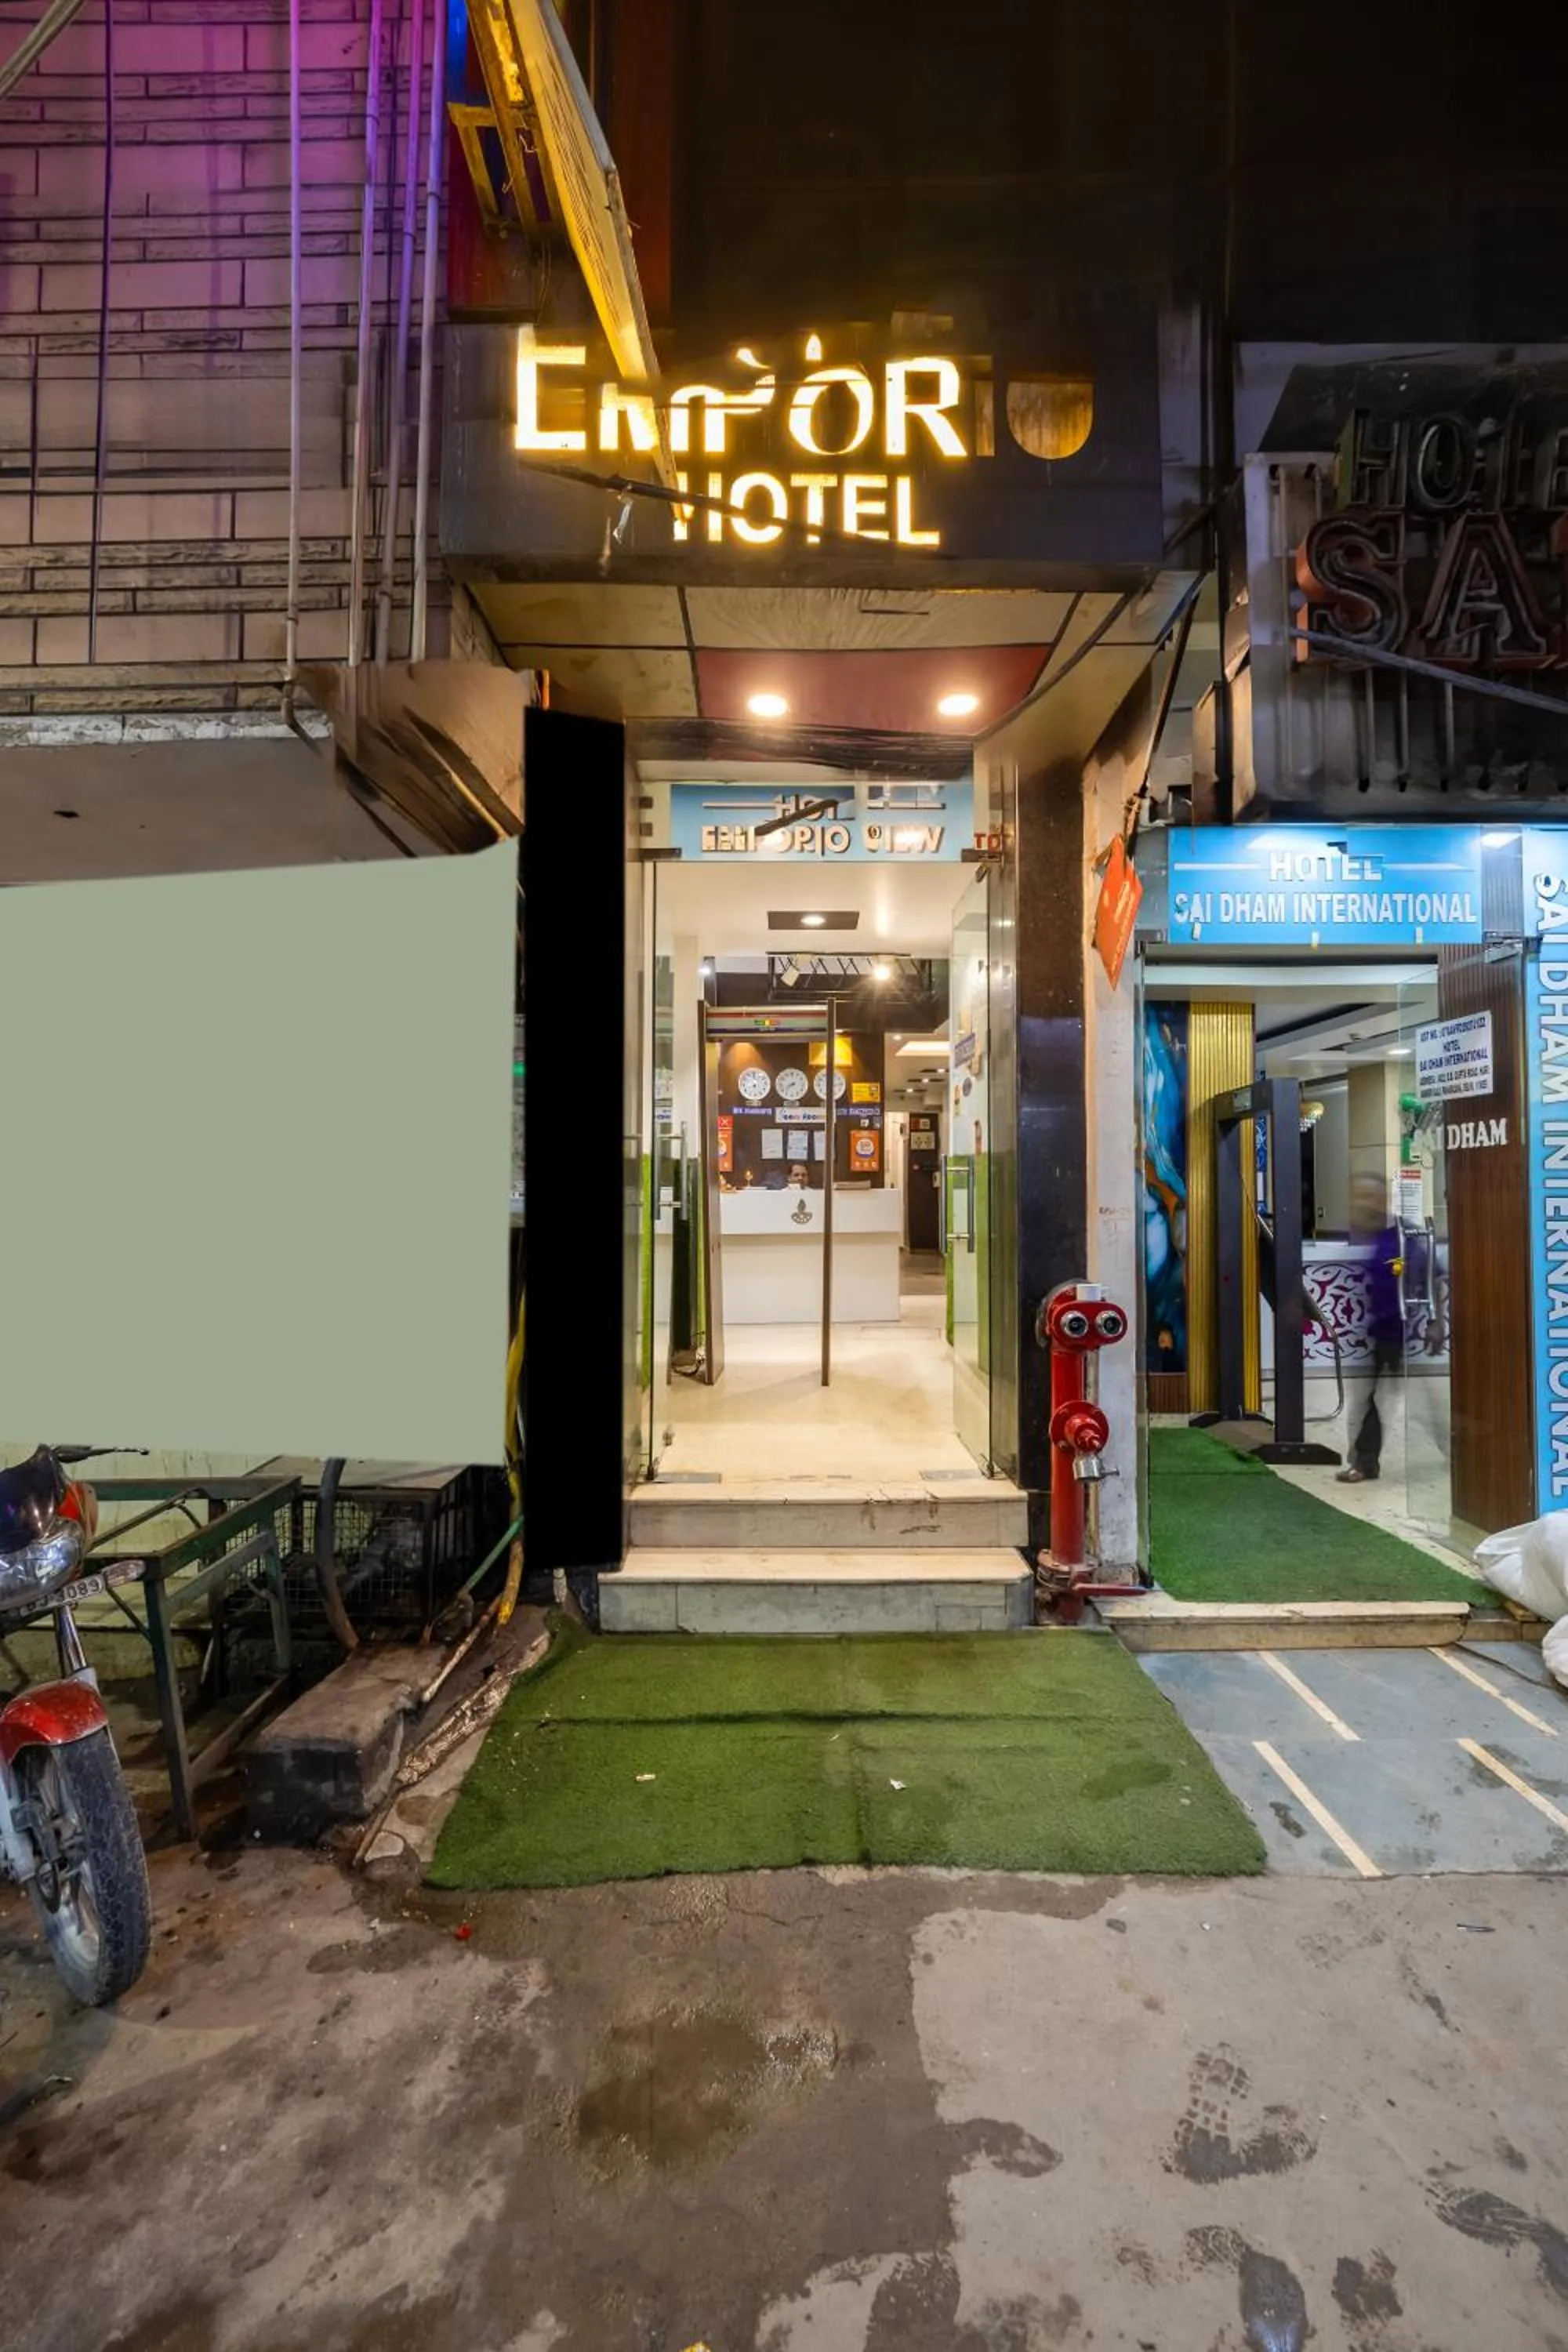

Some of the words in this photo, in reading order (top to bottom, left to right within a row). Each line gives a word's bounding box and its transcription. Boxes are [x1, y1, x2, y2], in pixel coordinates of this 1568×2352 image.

[672, 472, 940, 546] HOTEL
[1268, 851, 1383, 881] HOTEL
[1174, 892, 1212, 924] SAI
[1219, 892, 1286, 924] DHAM
[1293, 892, 1478, 924] INTERNATIONAL
[1446, 1117, 1508, 1151] DHAM
